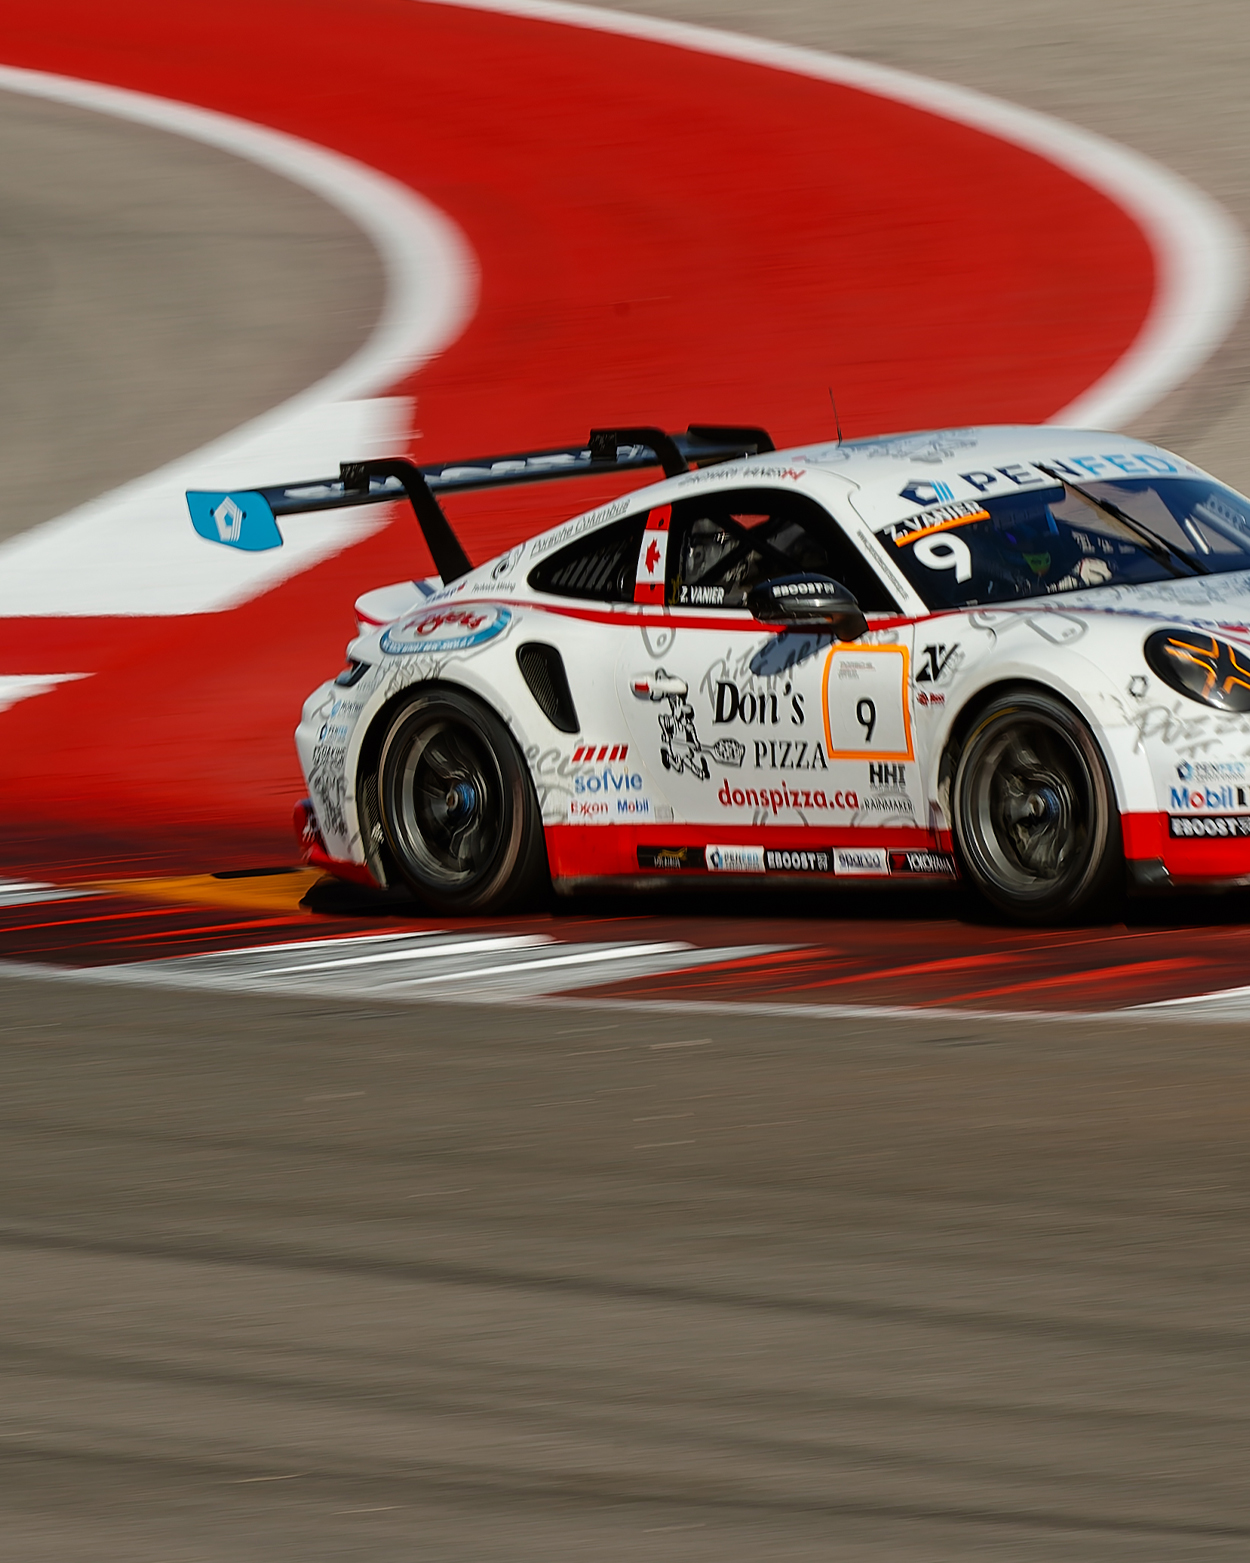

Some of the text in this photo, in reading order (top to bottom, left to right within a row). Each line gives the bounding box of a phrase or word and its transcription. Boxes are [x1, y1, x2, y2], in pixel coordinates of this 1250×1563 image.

[957, 453, 1179, 493] PENFED
[903, 501, 985, 532] VANIER
[913, 531, 972, 584] 9
[690, 585, 725, 605] VANIER
[712, 680, 806, 726] Don's
[856, 697, 877, 743] 9
[753, 739, 829, 771] PIZZA
[574, 766, 643, 793] sofvie
[869, 762, 906, 785] HHI
[570, 798, 650, 818] Exxon Mobil
[718, 777, 860, 816] donspizza.ca
[1170, 785, 1234, 809] Mobil
[767, 850, 816, 870] EBOOST
